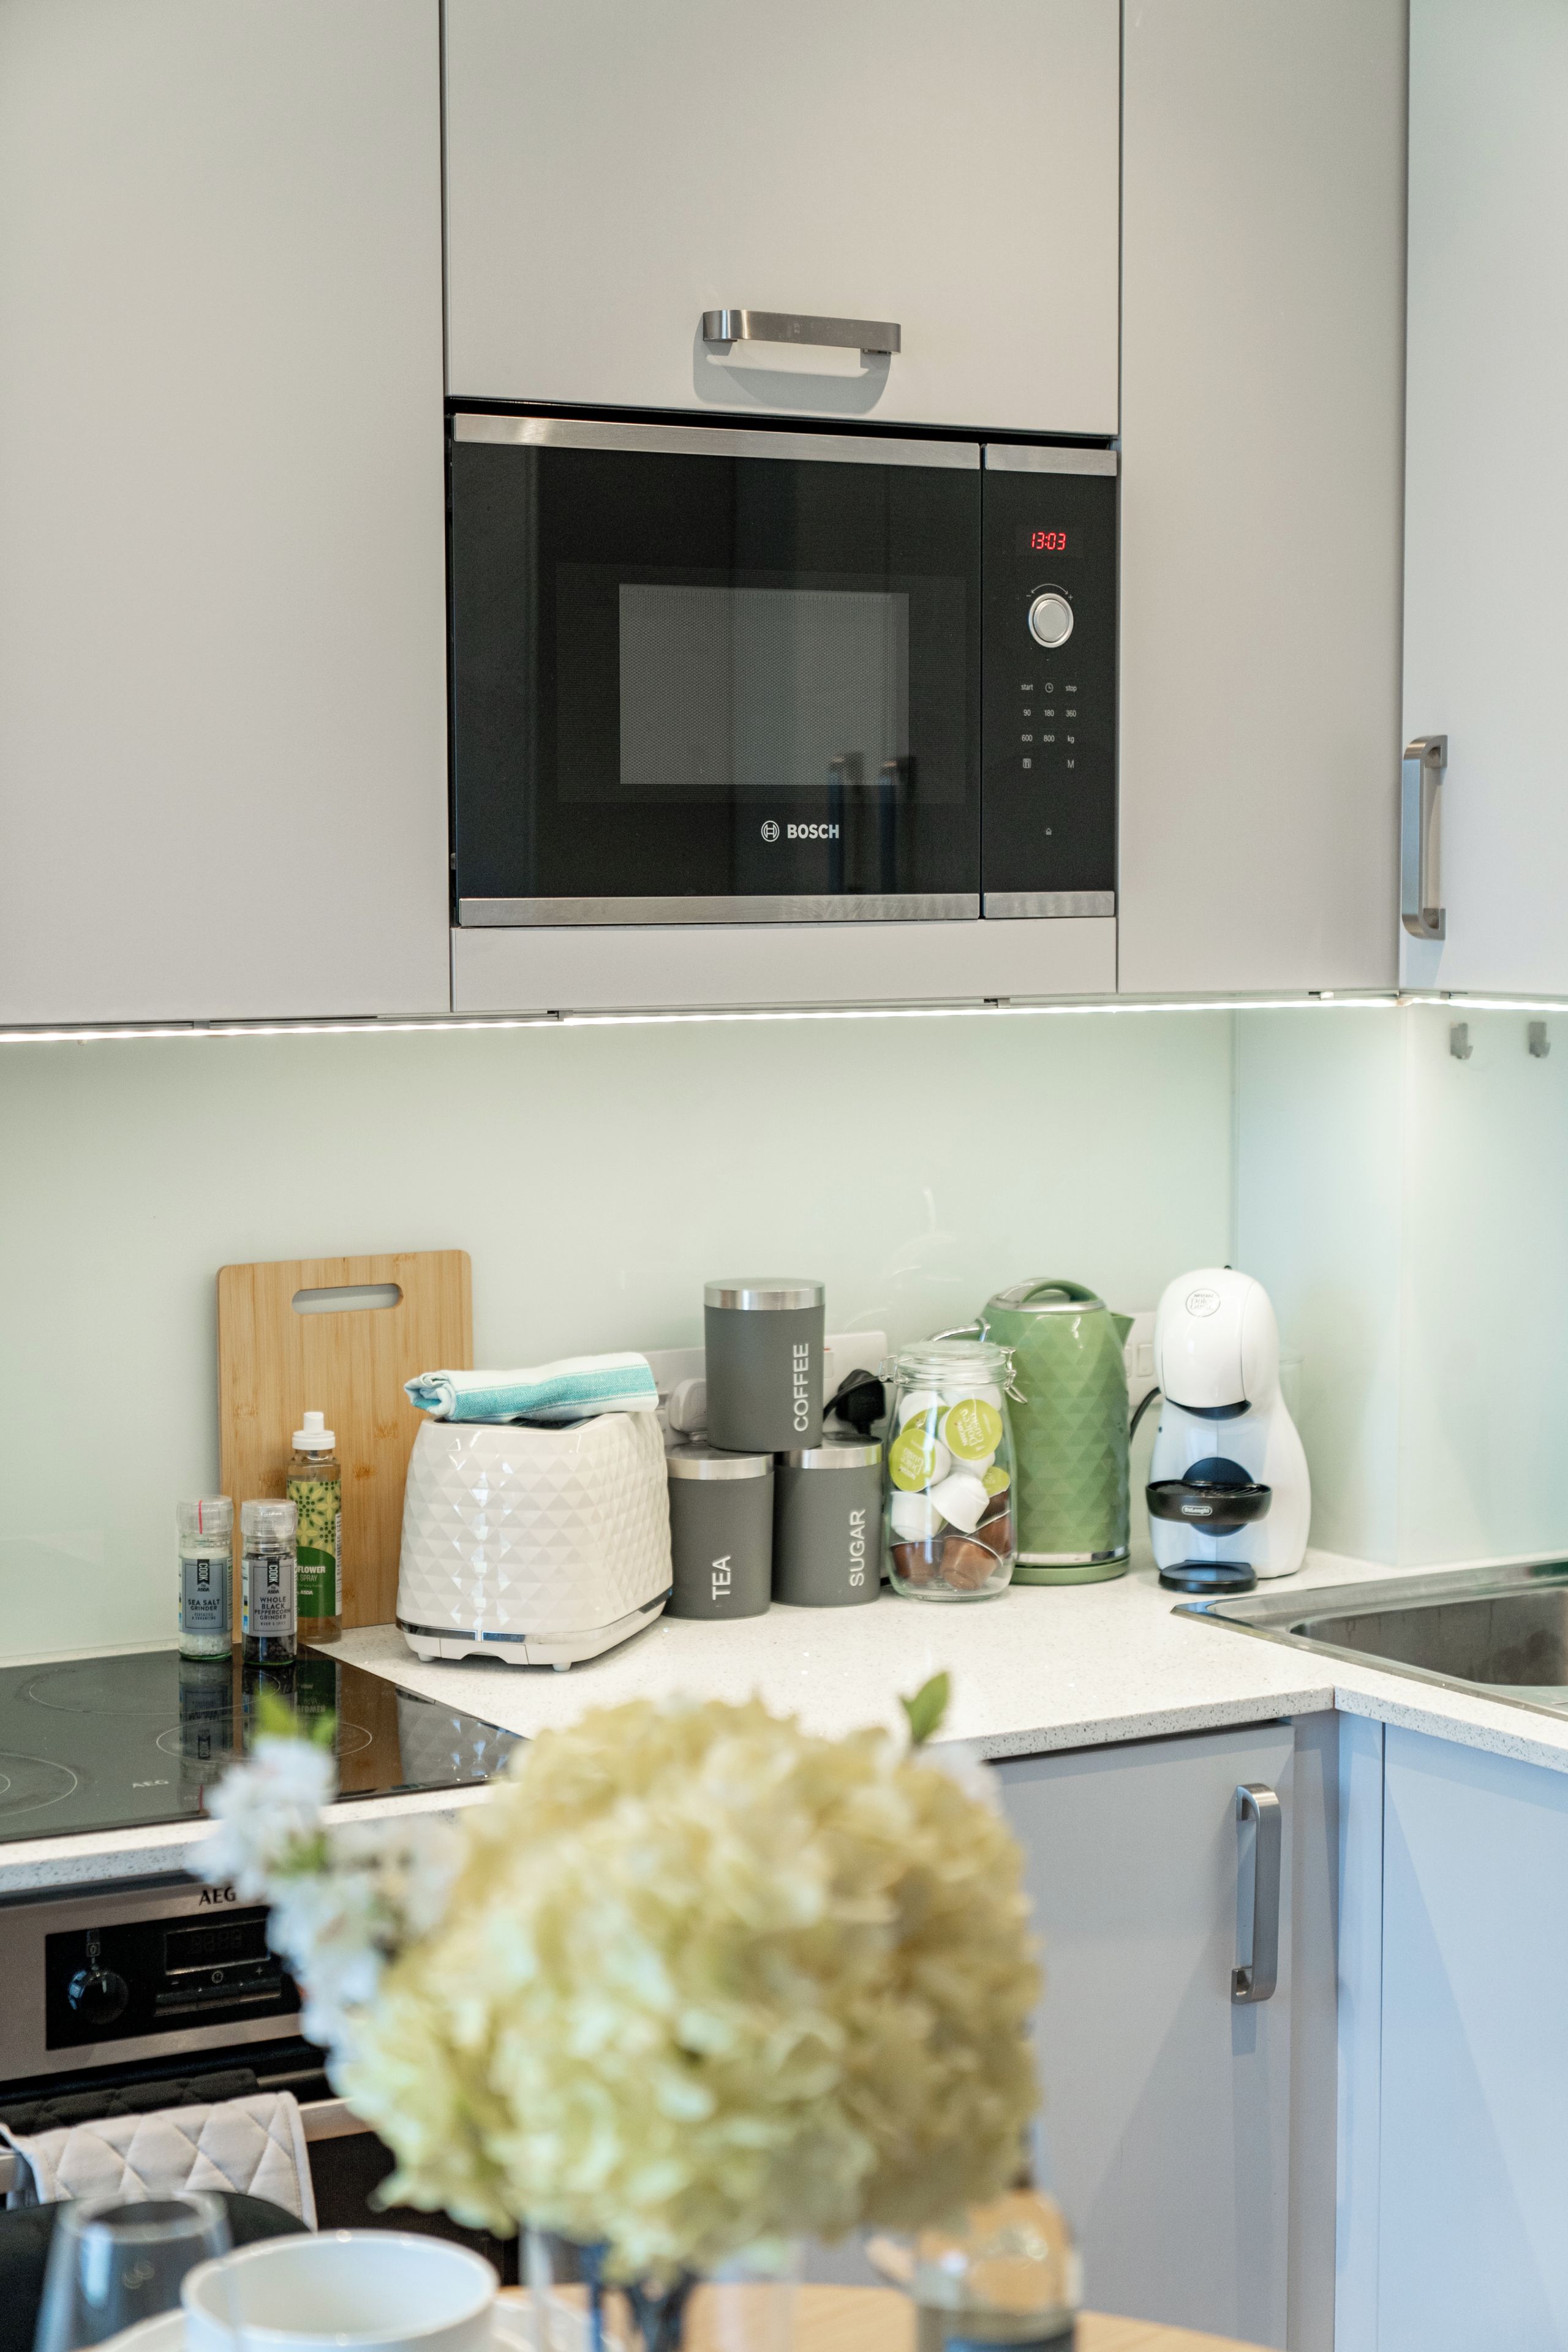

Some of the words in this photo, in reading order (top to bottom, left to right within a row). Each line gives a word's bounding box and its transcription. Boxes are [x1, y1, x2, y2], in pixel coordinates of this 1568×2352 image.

[1031, 532, 1066, 550] 13:03
[1068, 760, 1074, 768] M
[787, 824, 839, 839] BOSCH
[793, 1343, 809, 1432] COFFEE
[850, 1509, 865, 1586] SUGAR
[198, 1563, 208, 1580] COOK
[268, 1565, 278, 1583] COOK
[712, 1556, 731, 1600] TEA
[198, 1887, 236, 1906] AEG
